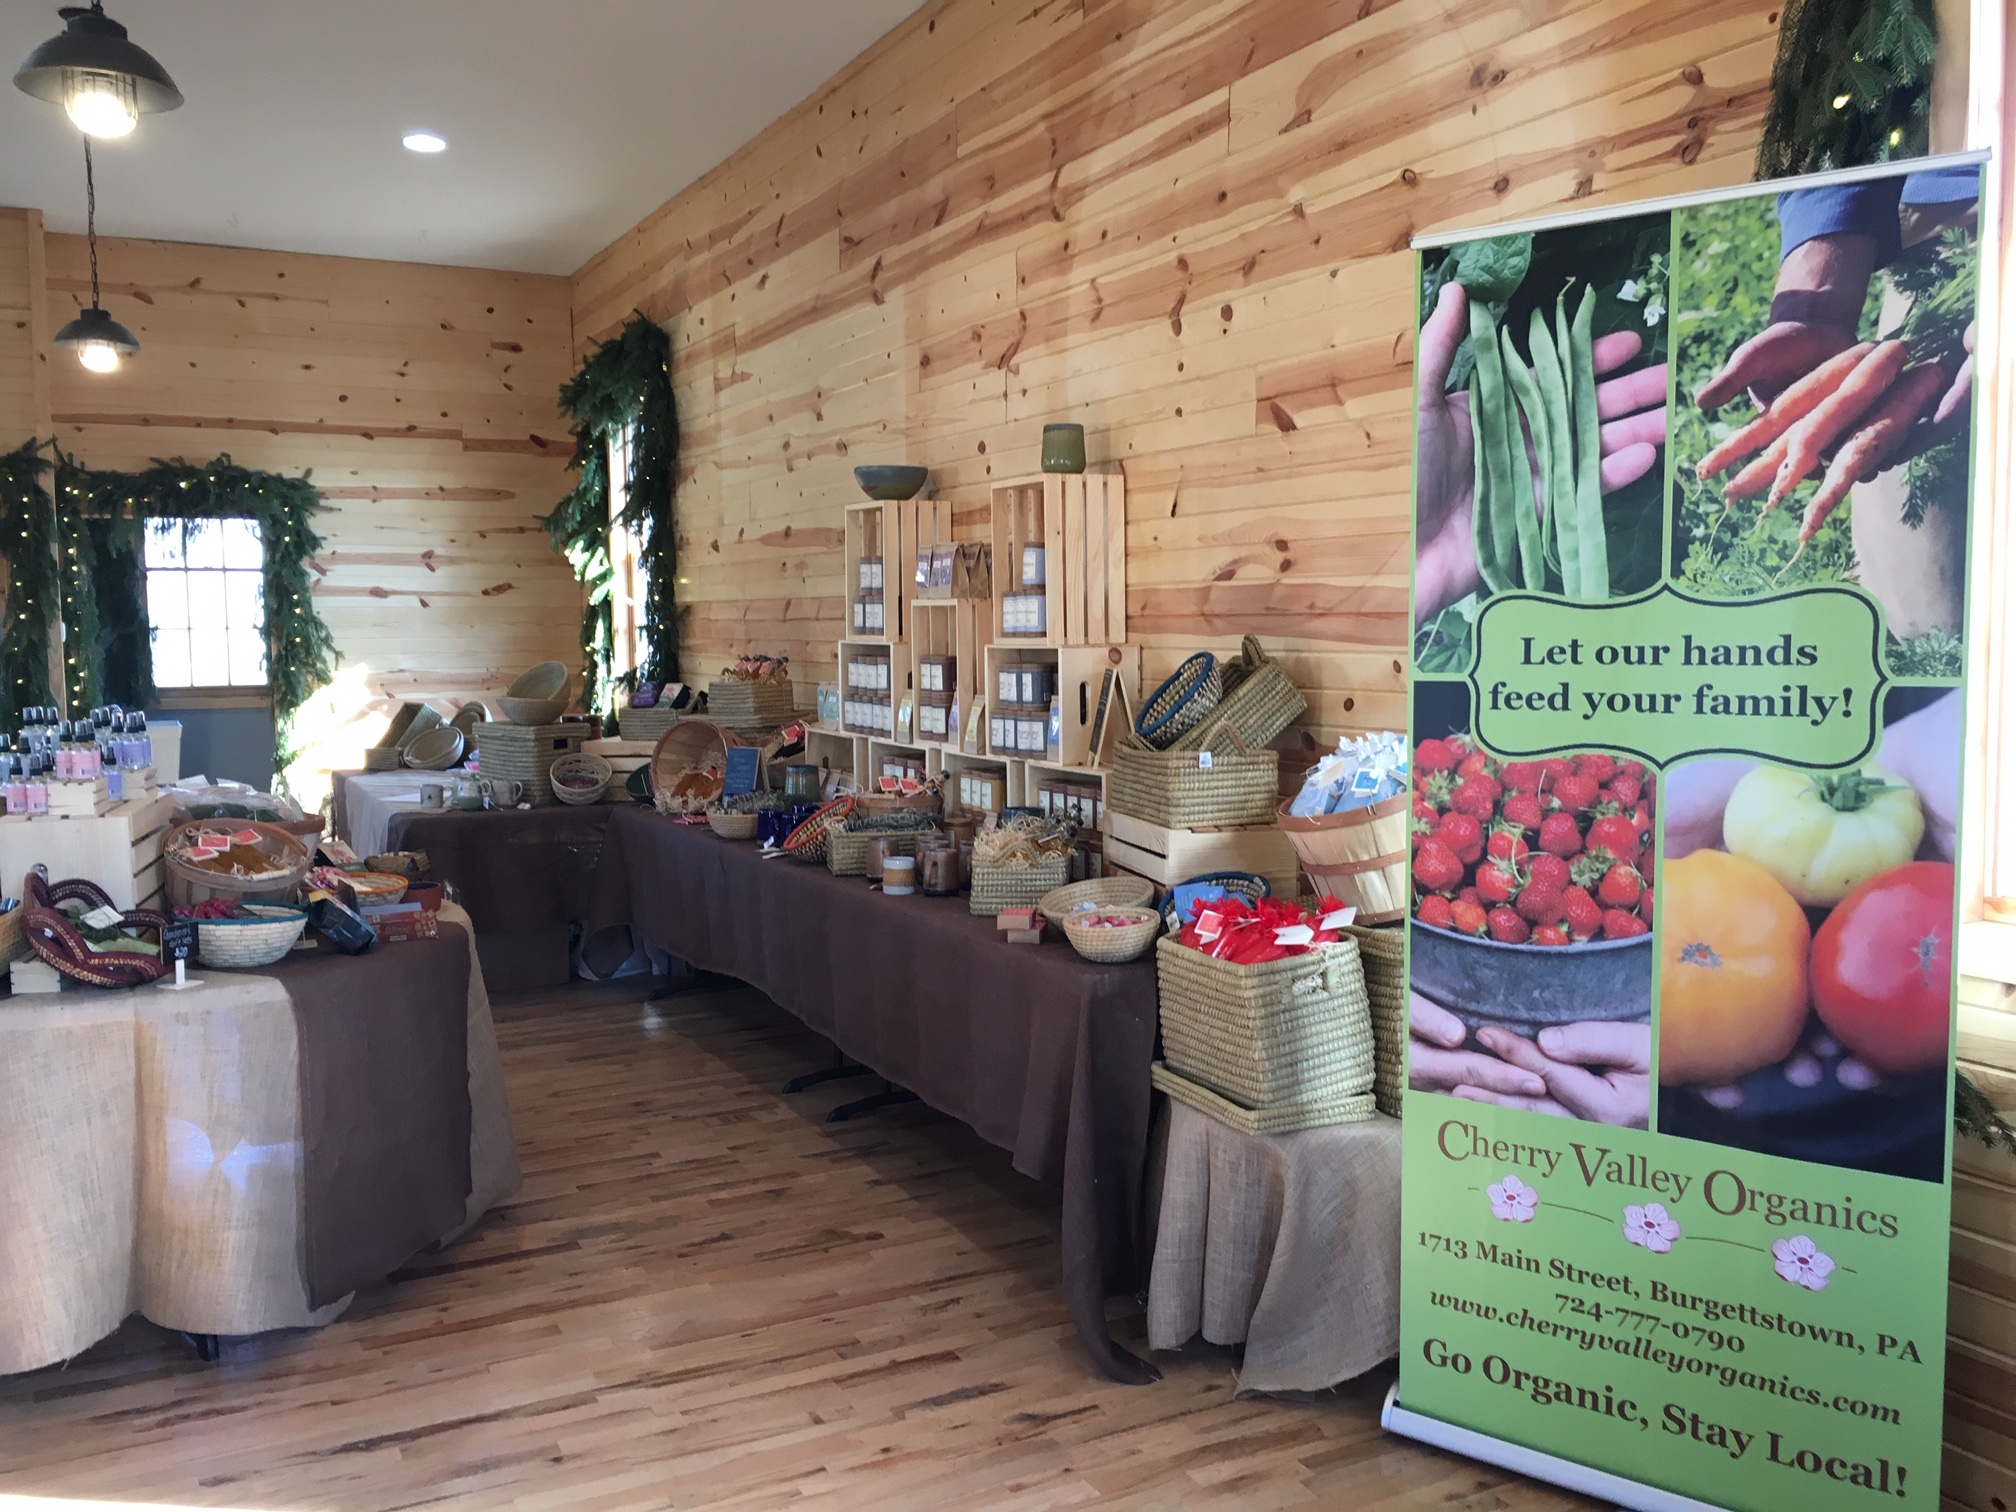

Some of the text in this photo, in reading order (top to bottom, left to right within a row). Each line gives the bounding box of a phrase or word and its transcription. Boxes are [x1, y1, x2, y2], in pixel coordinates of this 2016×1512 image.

[1488, 681, 1854, 726] feed your family!
[1519, 634, 1819, 667] Let our hands
[1437, 1119, 1899, 1238] Cherry Valley Organics
[1418, 1231, 1925, 1365] 1713 Main Street, Burgettstown, PA
[1429, 1289, 1902, 1425] www.cherryvalleyorganics.com
[1554, 1293, 1746, 1354] 724-777-0790
[1422, 1338, 1909, 1498] Go Organic, Stay Local!
